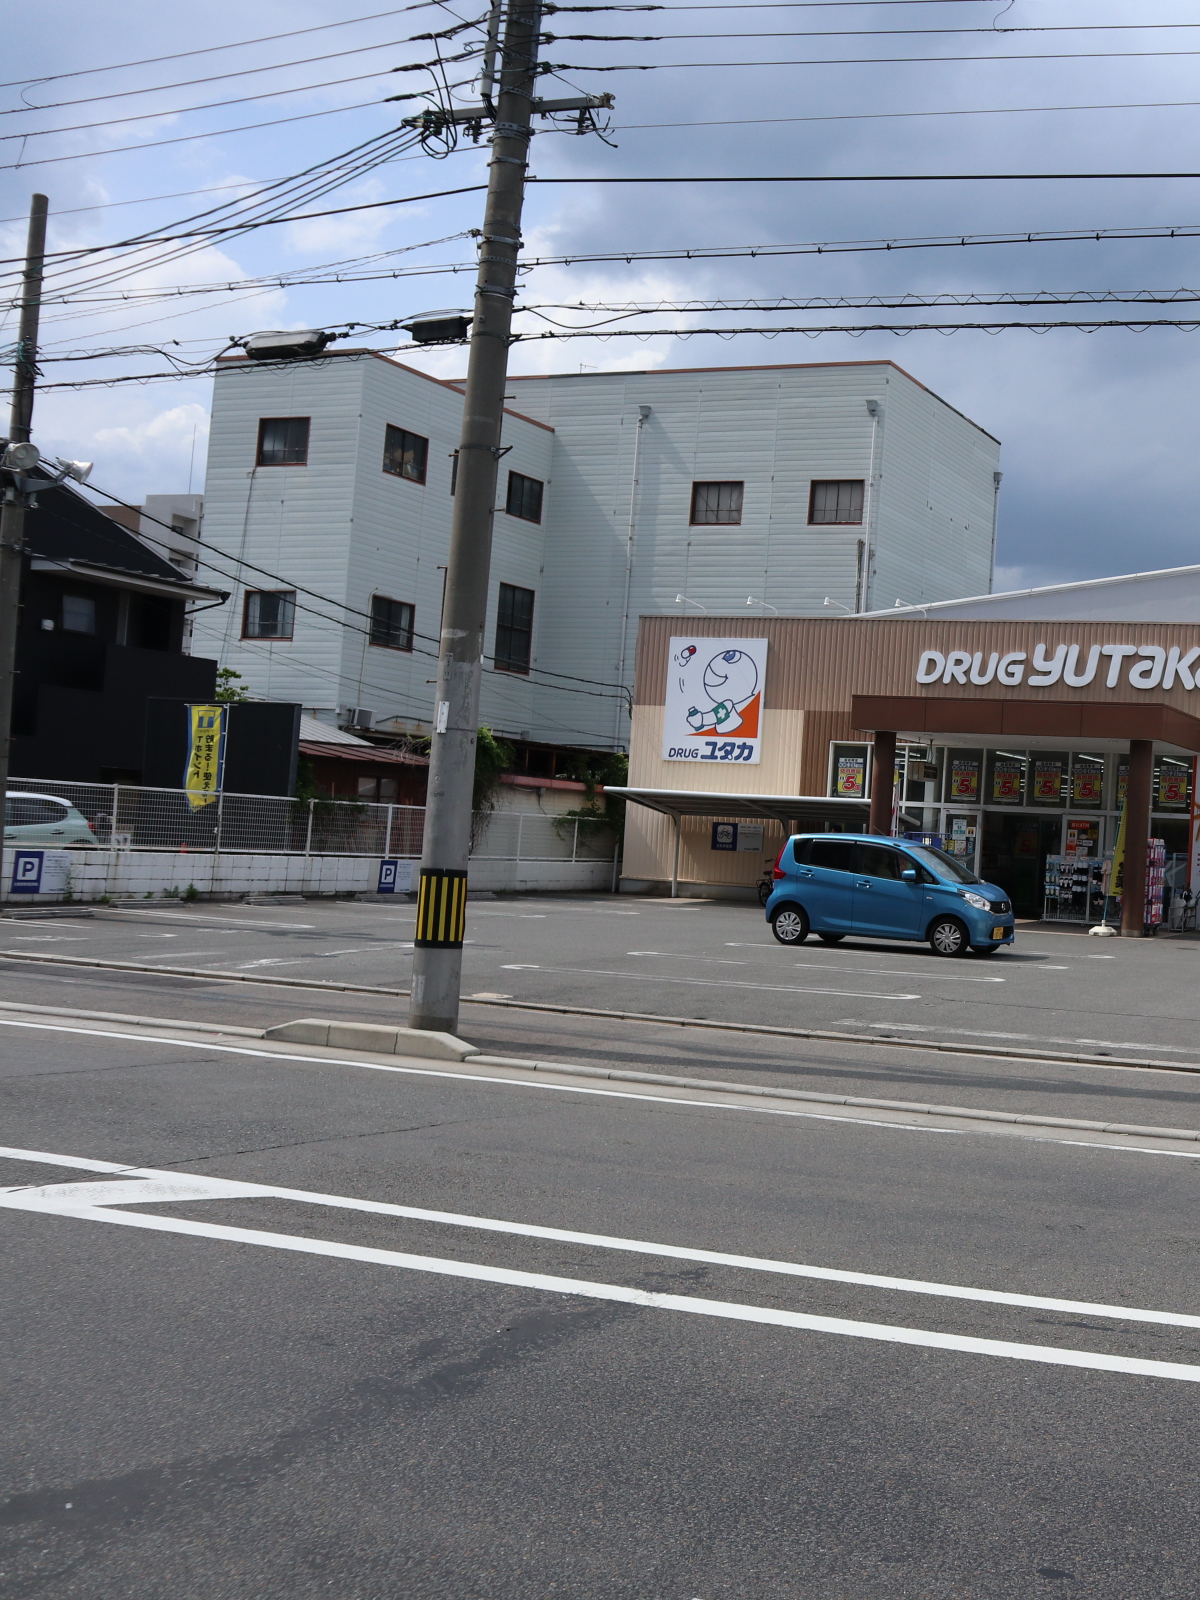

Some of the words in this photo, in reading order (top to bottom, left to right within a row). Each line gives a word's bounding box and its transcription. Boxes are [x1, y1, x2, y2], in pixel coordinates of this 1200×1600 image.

[916, 650, 1027, 686] DRUG
[668, 747, 699, 759] DRUG
[700, 741, 754, 761] ユタカ
[21, 860, 35, 878] P
[384, 867, 393, 881] P
